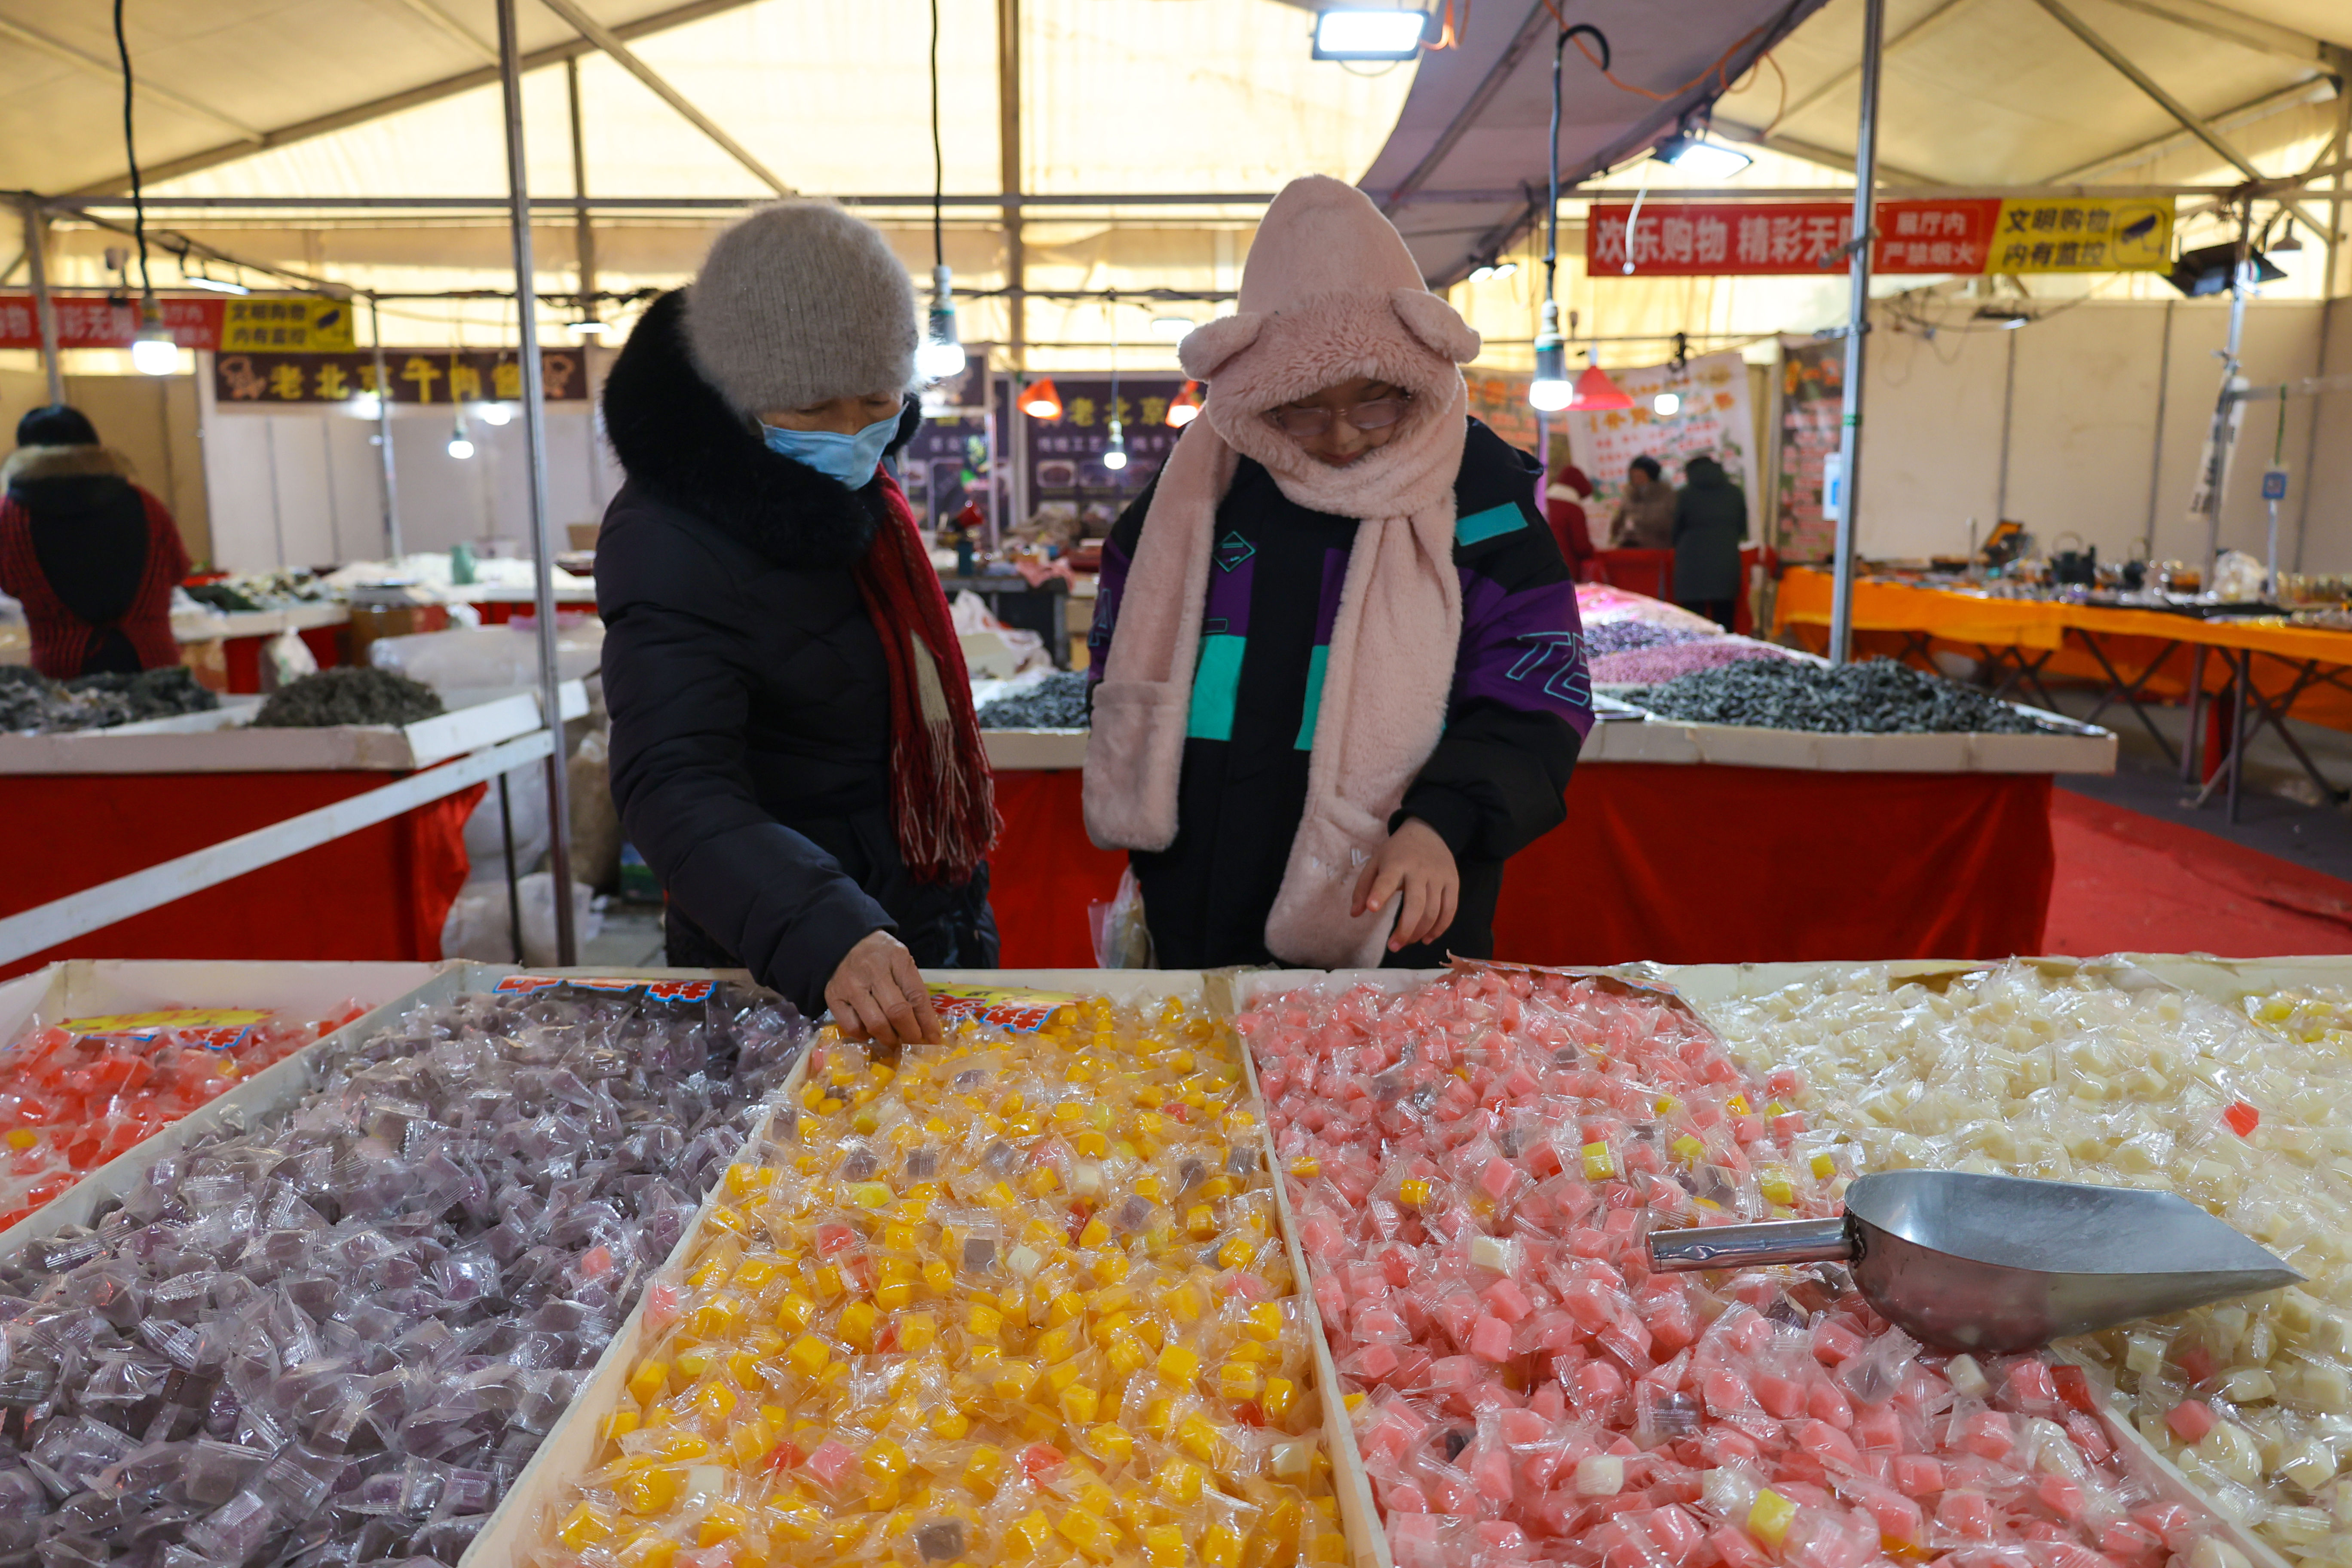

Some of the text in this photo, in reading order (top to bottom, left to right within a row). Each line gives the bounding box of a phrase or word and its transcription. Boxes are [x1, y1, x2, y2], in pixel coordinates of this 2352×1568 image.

[1895, 211, 1967, 237] 展厅内
[2005, 208, 2110, 235] 文明购物
[1596, 216, 1728, 263] 欢乐购物
[1881, 239, 1975, 266] 严禁烟火
[2002, 242, 2107, 268] 内有监控
[1068, 395, 1202, 427] 老北京
